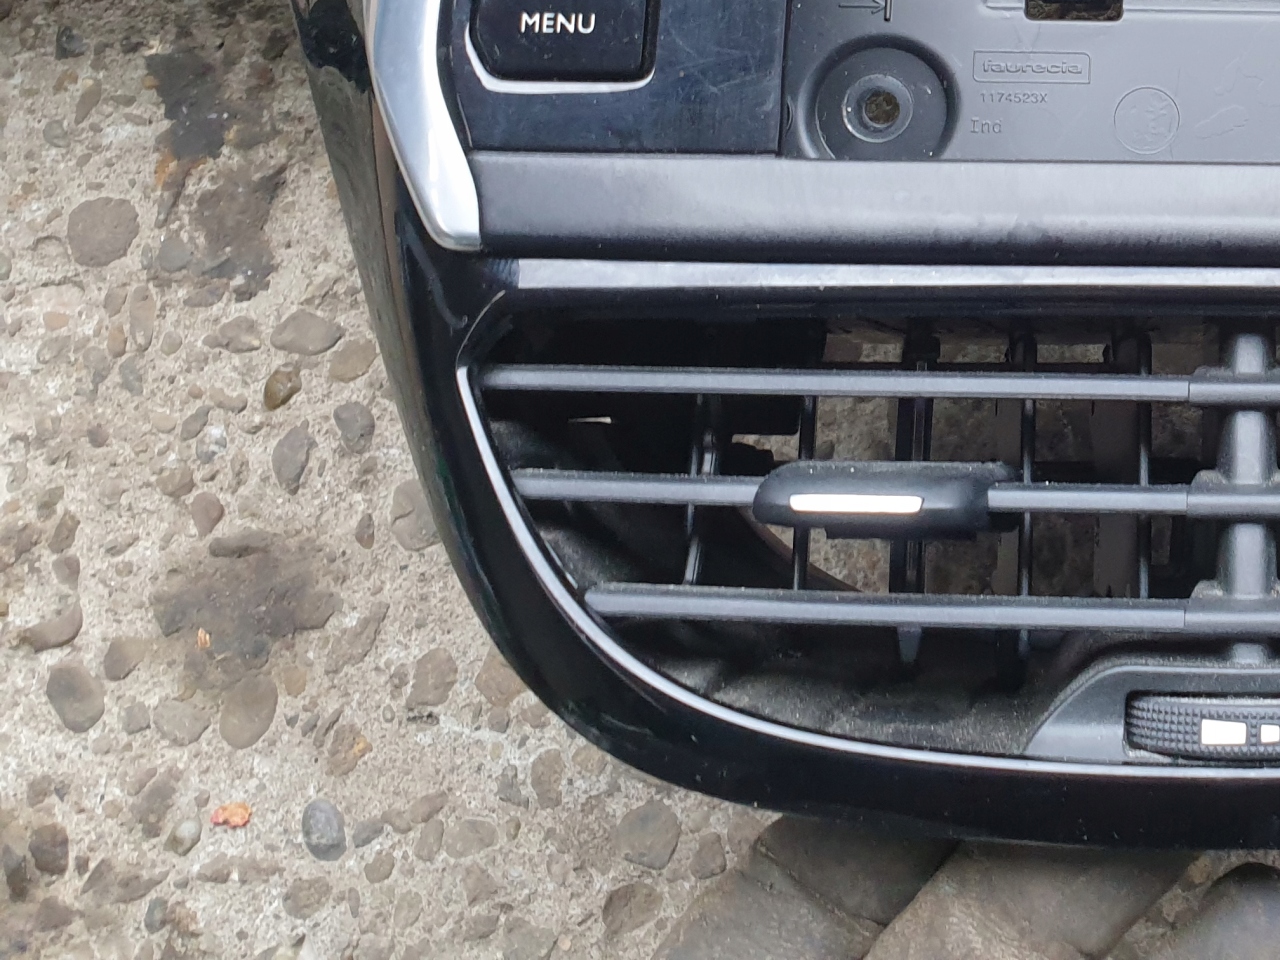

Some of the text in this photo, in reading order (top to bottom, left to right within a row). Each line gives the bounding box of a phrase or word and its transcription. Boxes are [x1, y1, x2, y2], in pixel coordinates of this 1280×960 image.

[520, 12, 595, 34] MENU
[982, 59, 1083, 75] faurecia
[980, 91, 1048, 104] 1174523X
